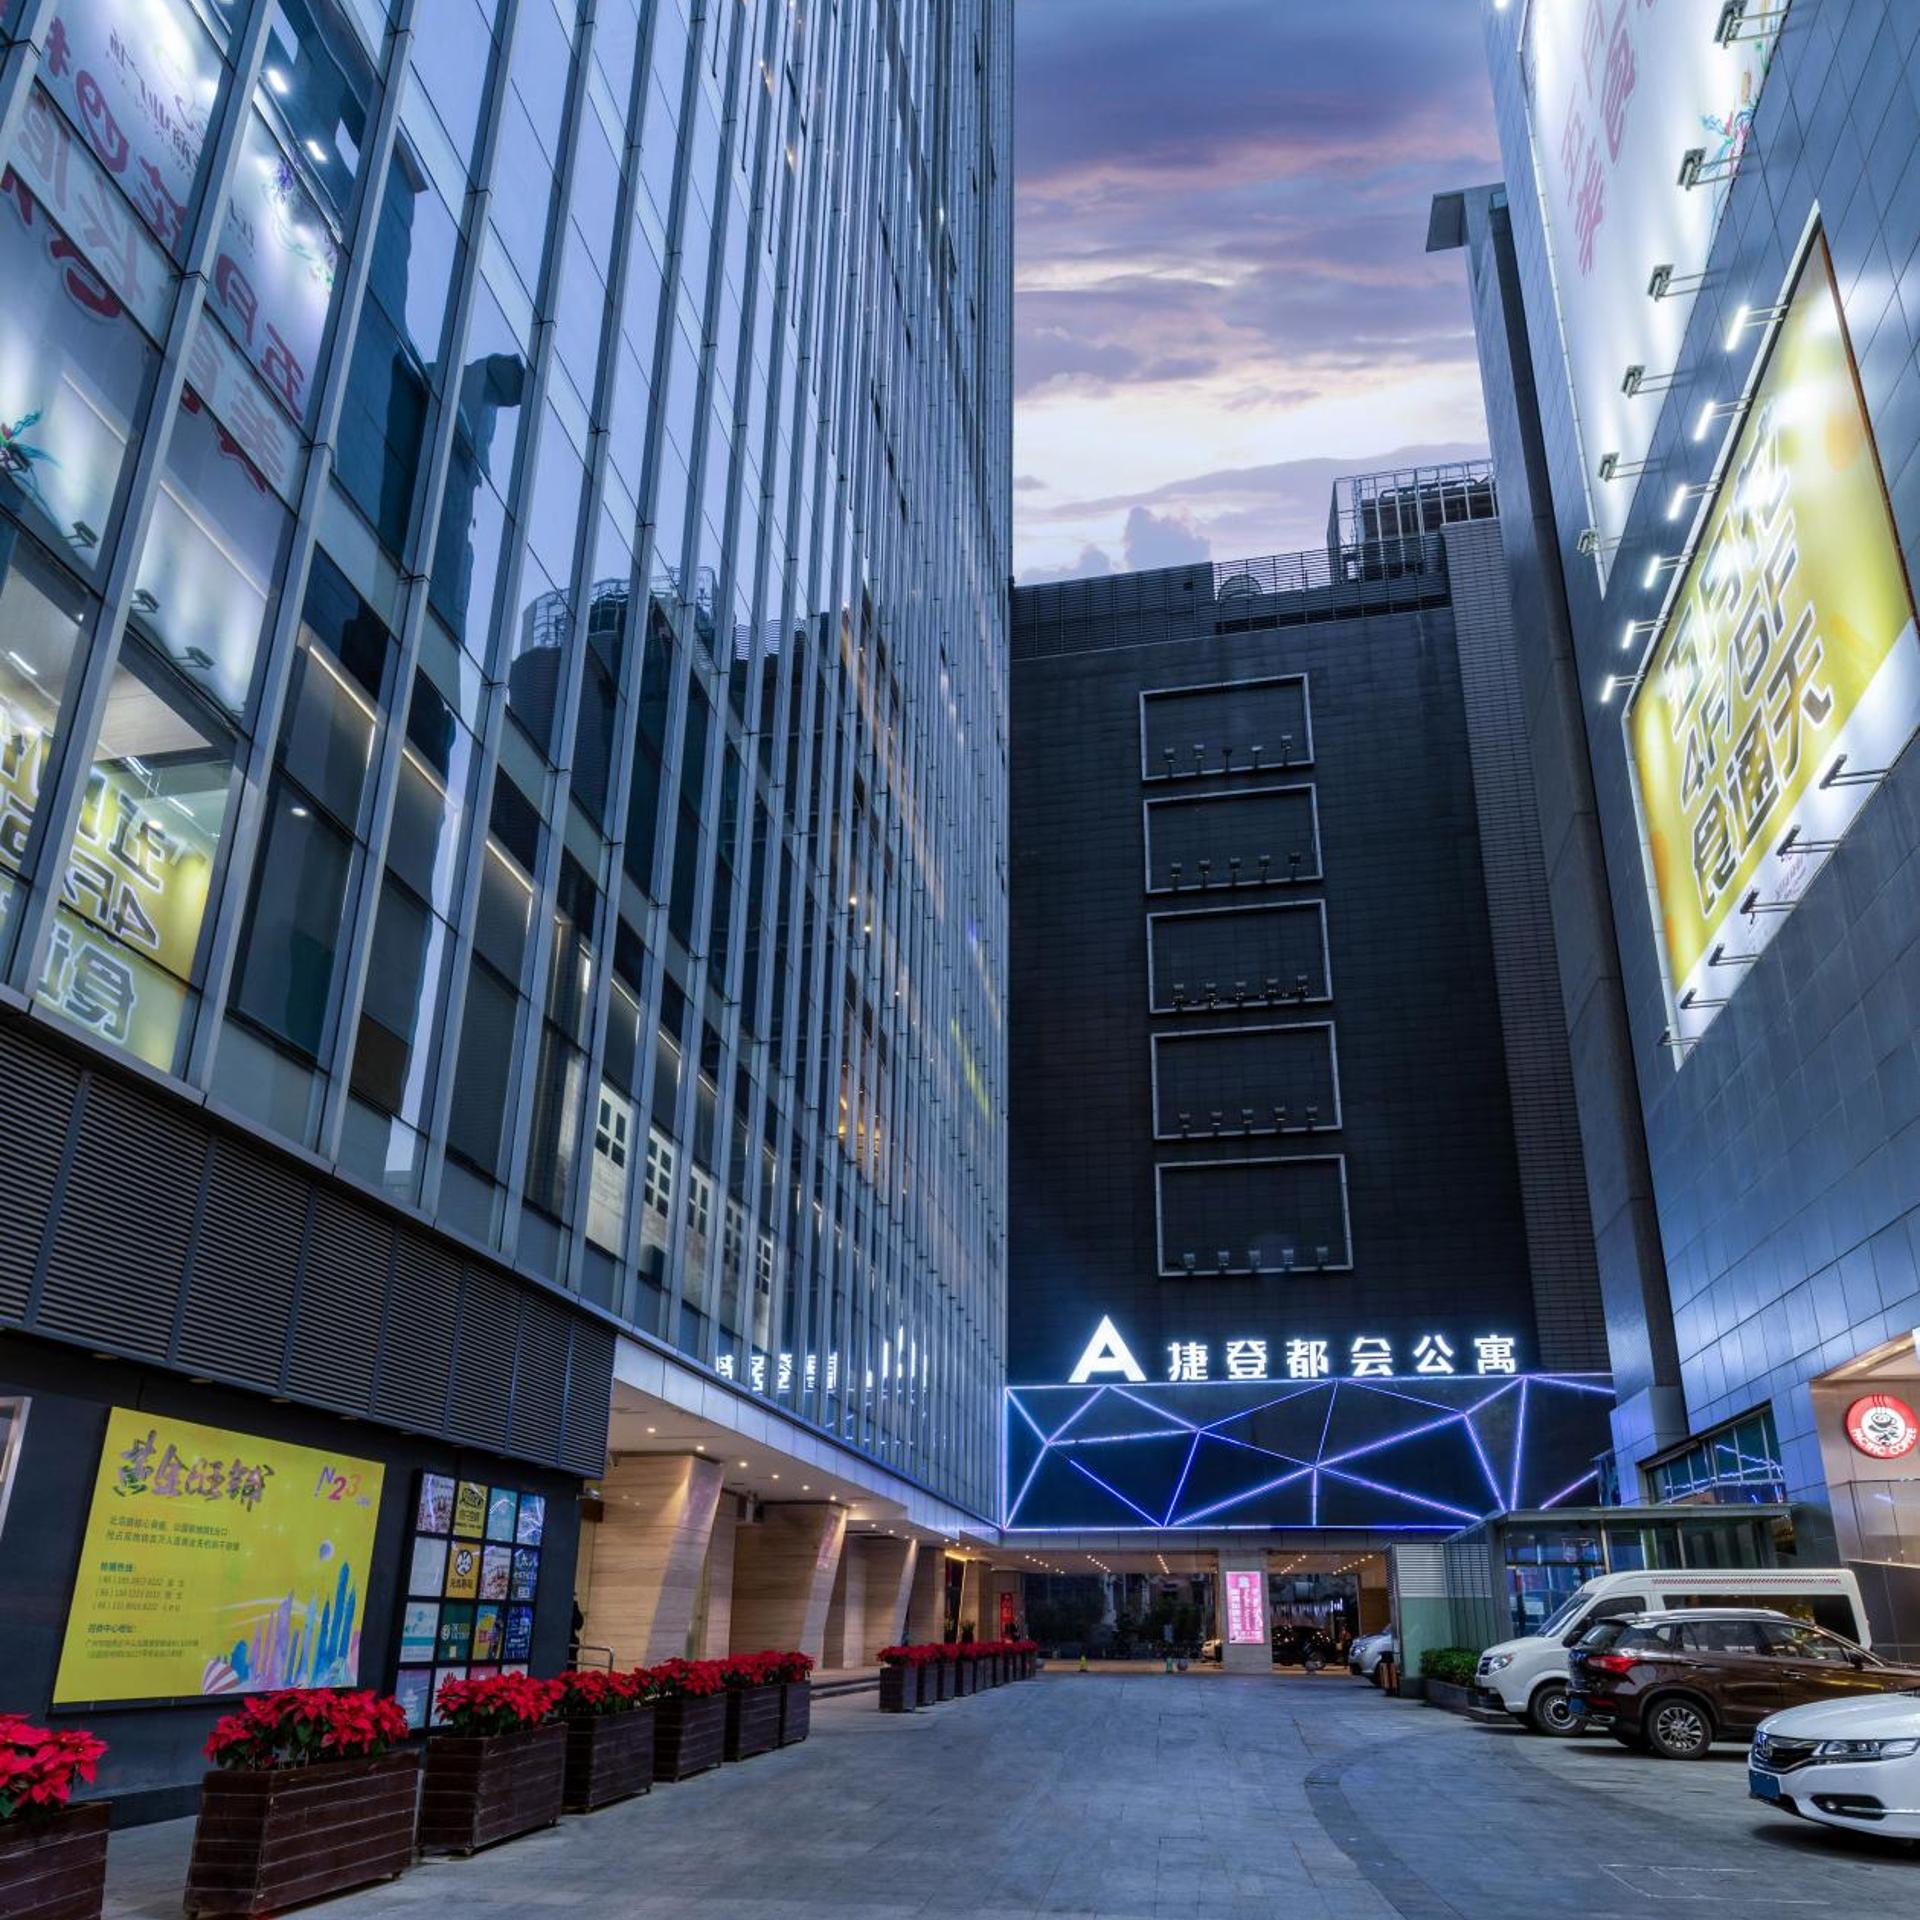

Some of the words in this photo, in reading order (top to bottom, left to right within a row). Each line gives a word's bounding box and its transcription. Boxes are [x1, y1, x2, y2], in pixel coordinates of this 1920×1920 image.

[1682, 509, 1799, 812] 4F/5F
[1692, 600, 1833, 919] 食通天
[1068, 1315, 1146, 1384] A
[1167, 1334, 1516, 1382] 捷登都会公寓
[113, 1429, 275, 1511] 黄金旺铺
[1850, 1428, 1886, 1455] PACIFIC
[1889, 1428, 1917, 1455] COFFEE
